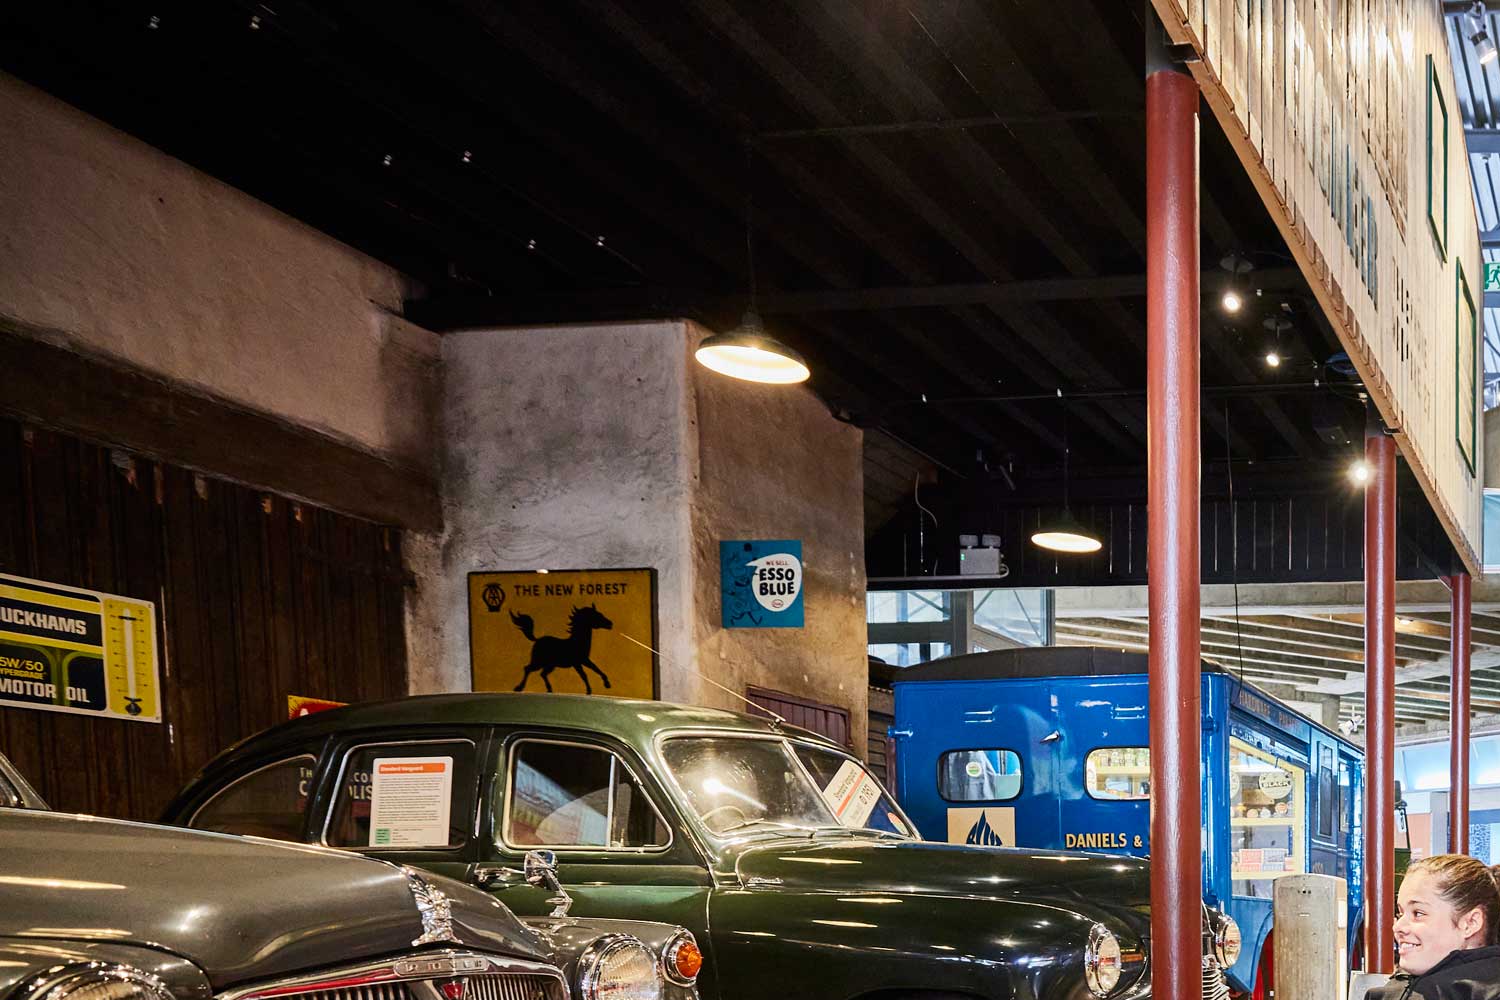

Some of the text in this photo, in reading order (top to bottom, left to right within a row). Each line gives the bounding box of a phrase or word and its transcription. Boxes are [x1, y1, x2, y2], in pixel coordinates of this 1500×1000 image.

[760, 567, 795, 581] ESSO
[514, 583, 627, 597] THE NEW FOREST
[760, 582, 795, 596] BLUE
[0, 606, 87, 636] UCKHAMS
[0, 678, 91, 703] MOTOR OIL
[1065, 833, 1143, 848] DANIELS &
